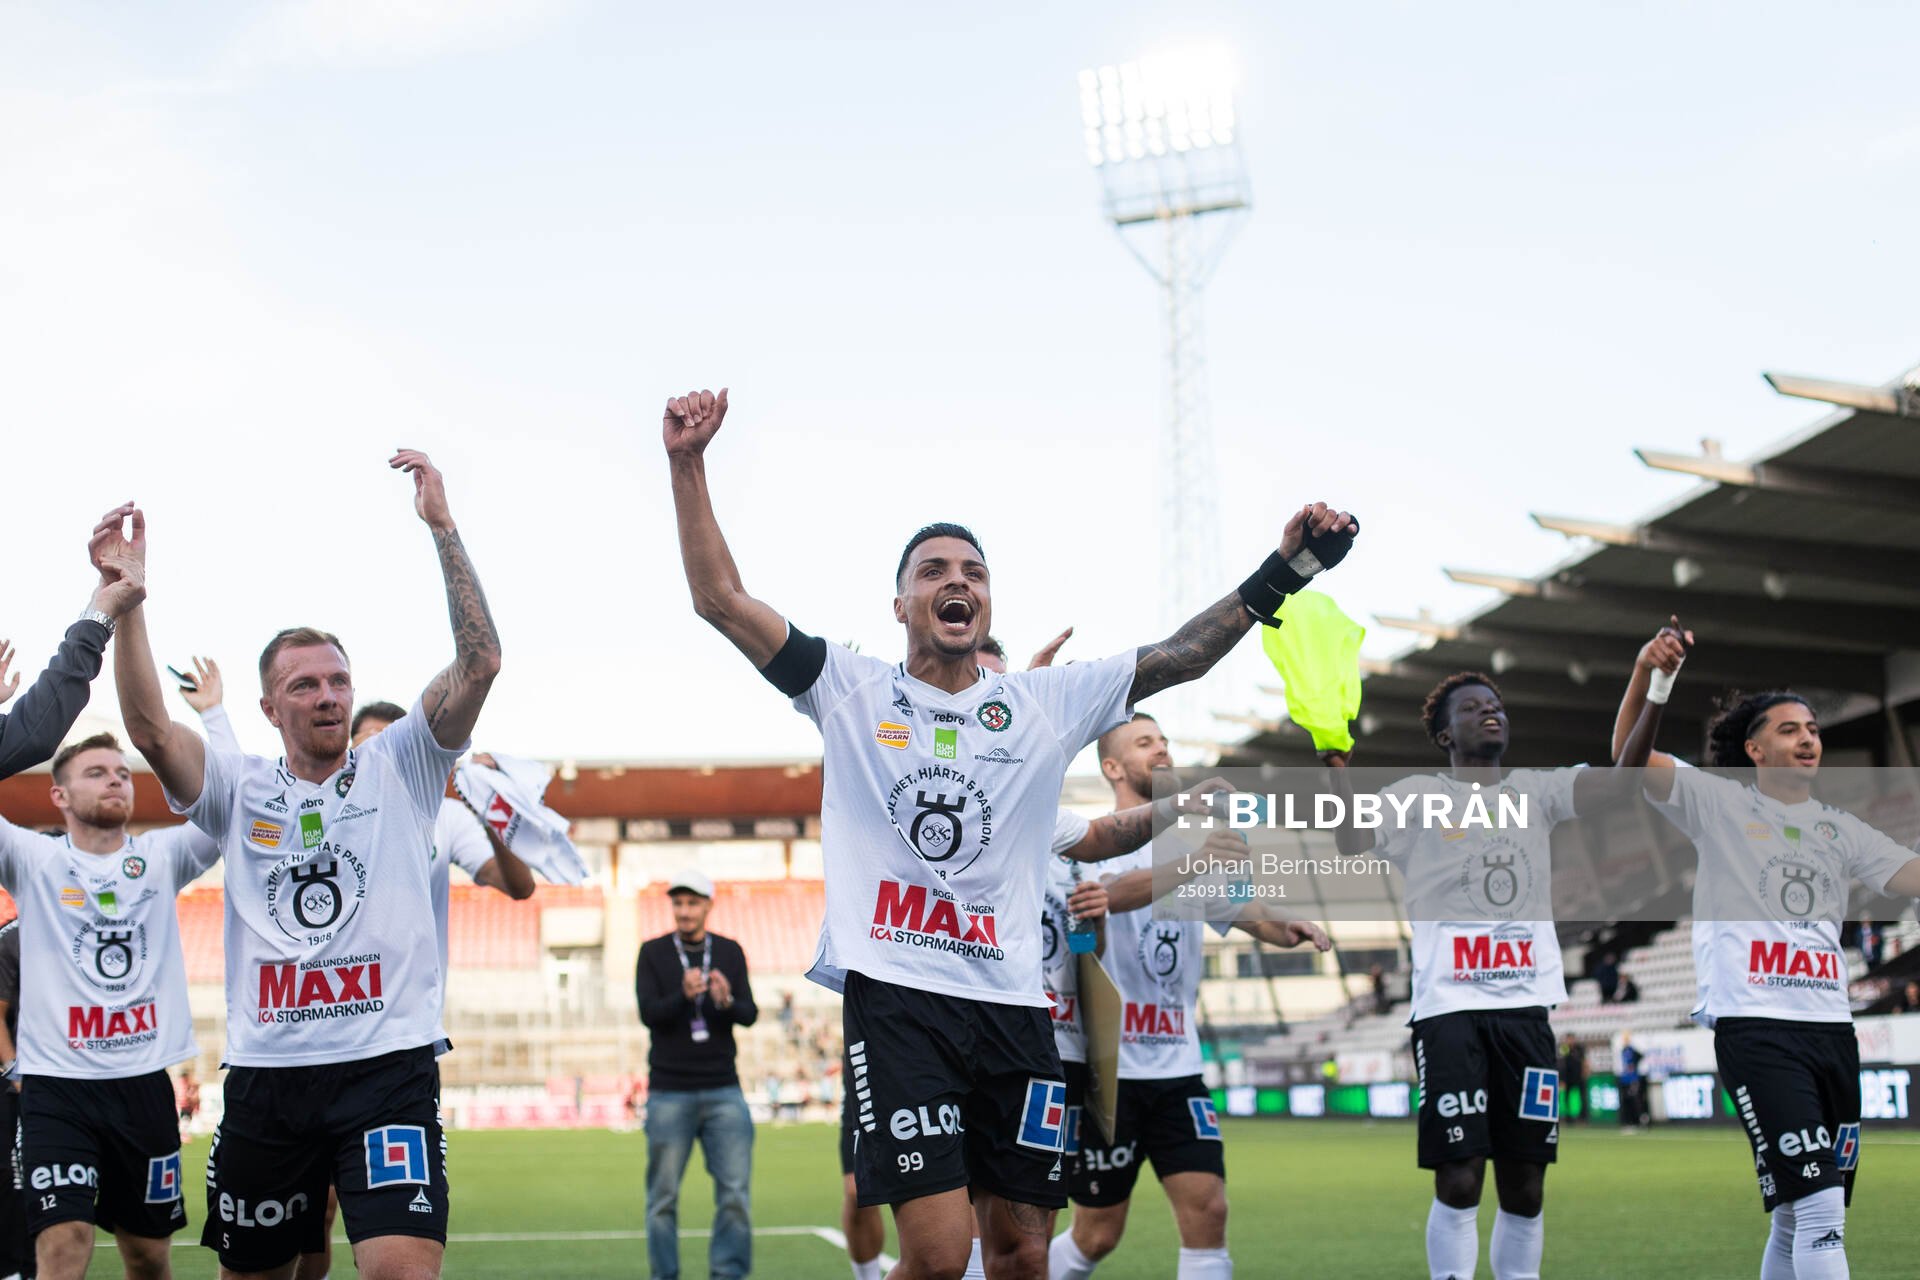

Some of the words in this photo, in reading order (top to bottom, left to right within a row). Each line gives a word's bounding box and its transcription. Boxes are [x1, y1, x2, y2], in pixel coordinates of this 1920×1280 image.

[929, 710, 965, 725] rebro
[264, 801, 289, 814] SELECT
[300, 798, 324, 810] ebro
[918, 764, 966, 785] HJÄRTA
[966, 780, 976, 791] &
[974, 790, 992, 846] PASSION
[342, 850, 367, 898] PASSION
[873, 880, 1000, 947] MAXI
[307, 932, 332, 946] 1908
[870, 927, 893, 941] ICA
[894, 931, 1004, 960] STORMARKNAD
[300, 953, 381, 971] BOGLUNDSÄNGEN
[1453, 935, 1536, 970] MAX
[1750, 940, 1839, 980] MAXI
[258, 962, 382, 1009] MAXI
[68, 1003, 157, 1039] MAXI
[258, 1010, 275, 1024] ICA
[276, 1000, 384, 1023] STORMARKNAD
[1446, 1126, 1464, 1143] 19
[897, 1152, 924, 1173] 99
[1802, 1161, 1821, 1179] 45
[40, 1193, 57, 1211] 12
[408, 1203, 432, 1213] SELECT
[222, 1233, 230, 1249] 5
